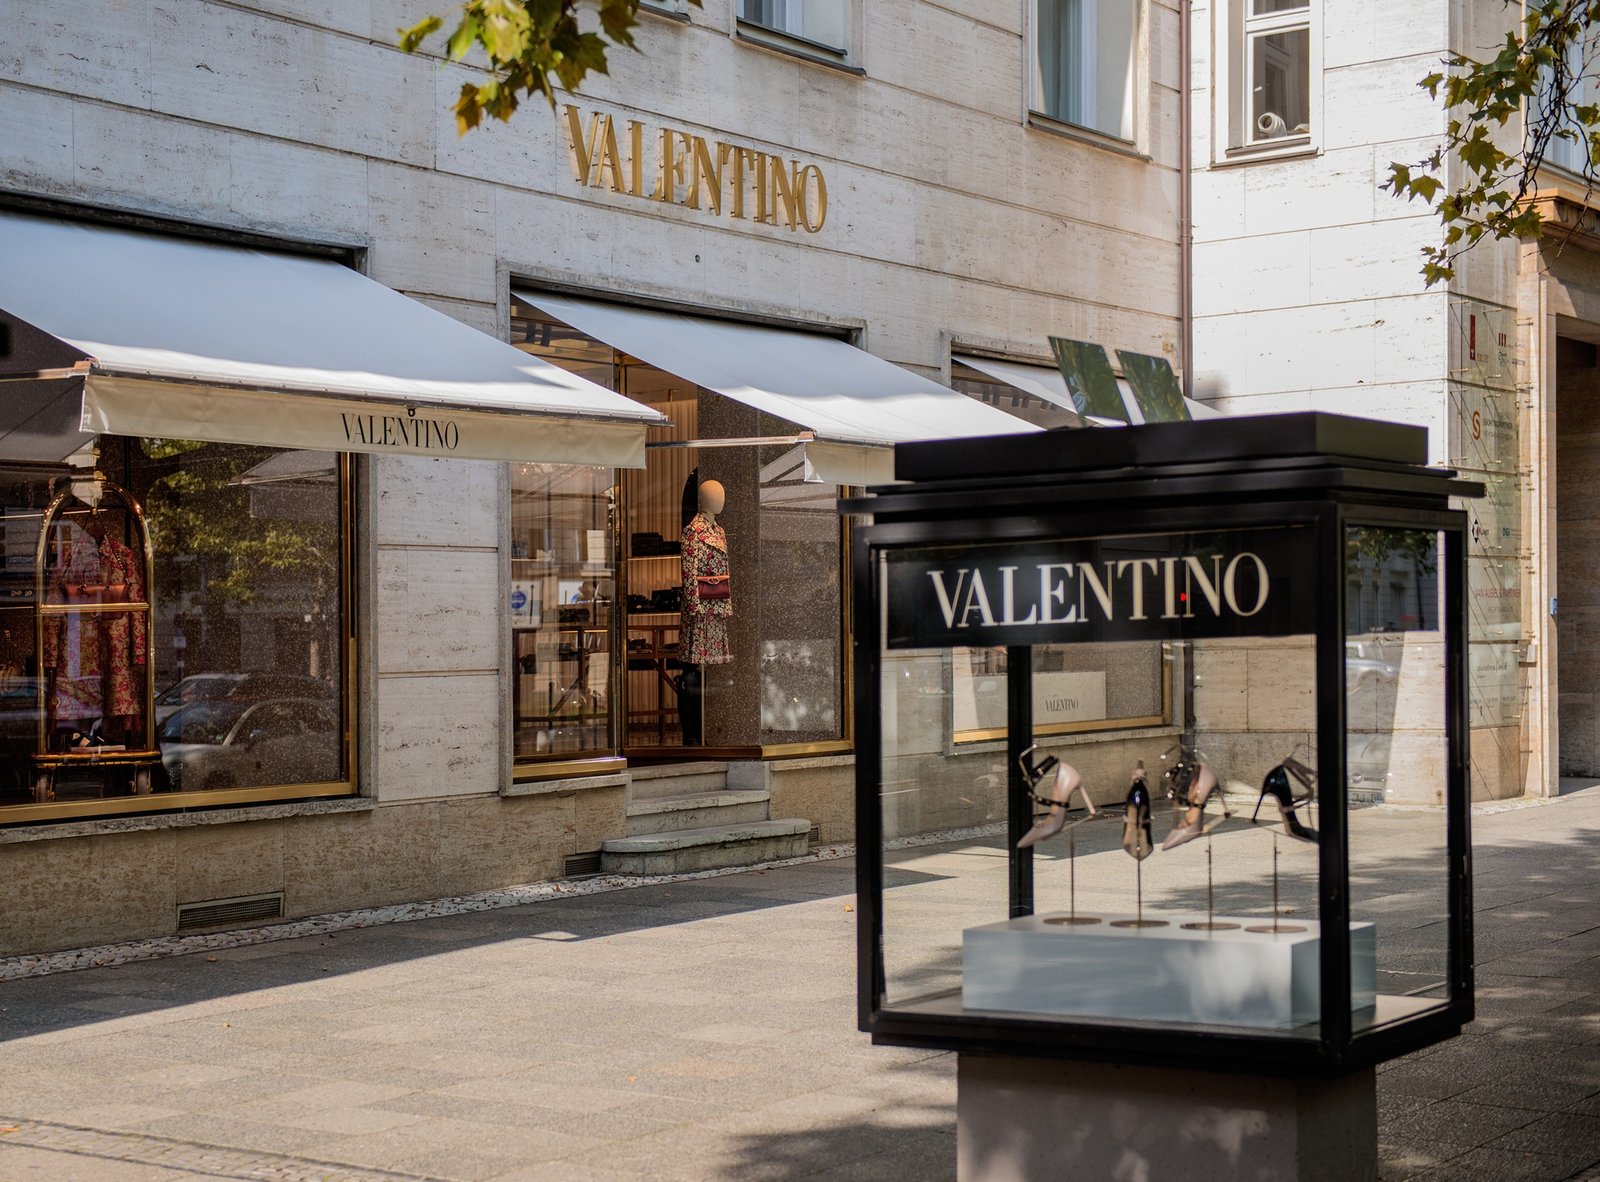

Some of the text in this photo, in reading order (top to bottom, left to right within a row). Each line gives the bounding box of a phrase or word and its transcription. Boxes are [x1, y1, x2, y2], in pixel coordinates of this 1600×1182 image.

[562, 103, 828, 233] VALENTINO
[340, 412, 459, 450] VALENTINO
[927, 551, 1270, 630] VALENTINO
[1045, 698, 1079, 712] VALENTINO
